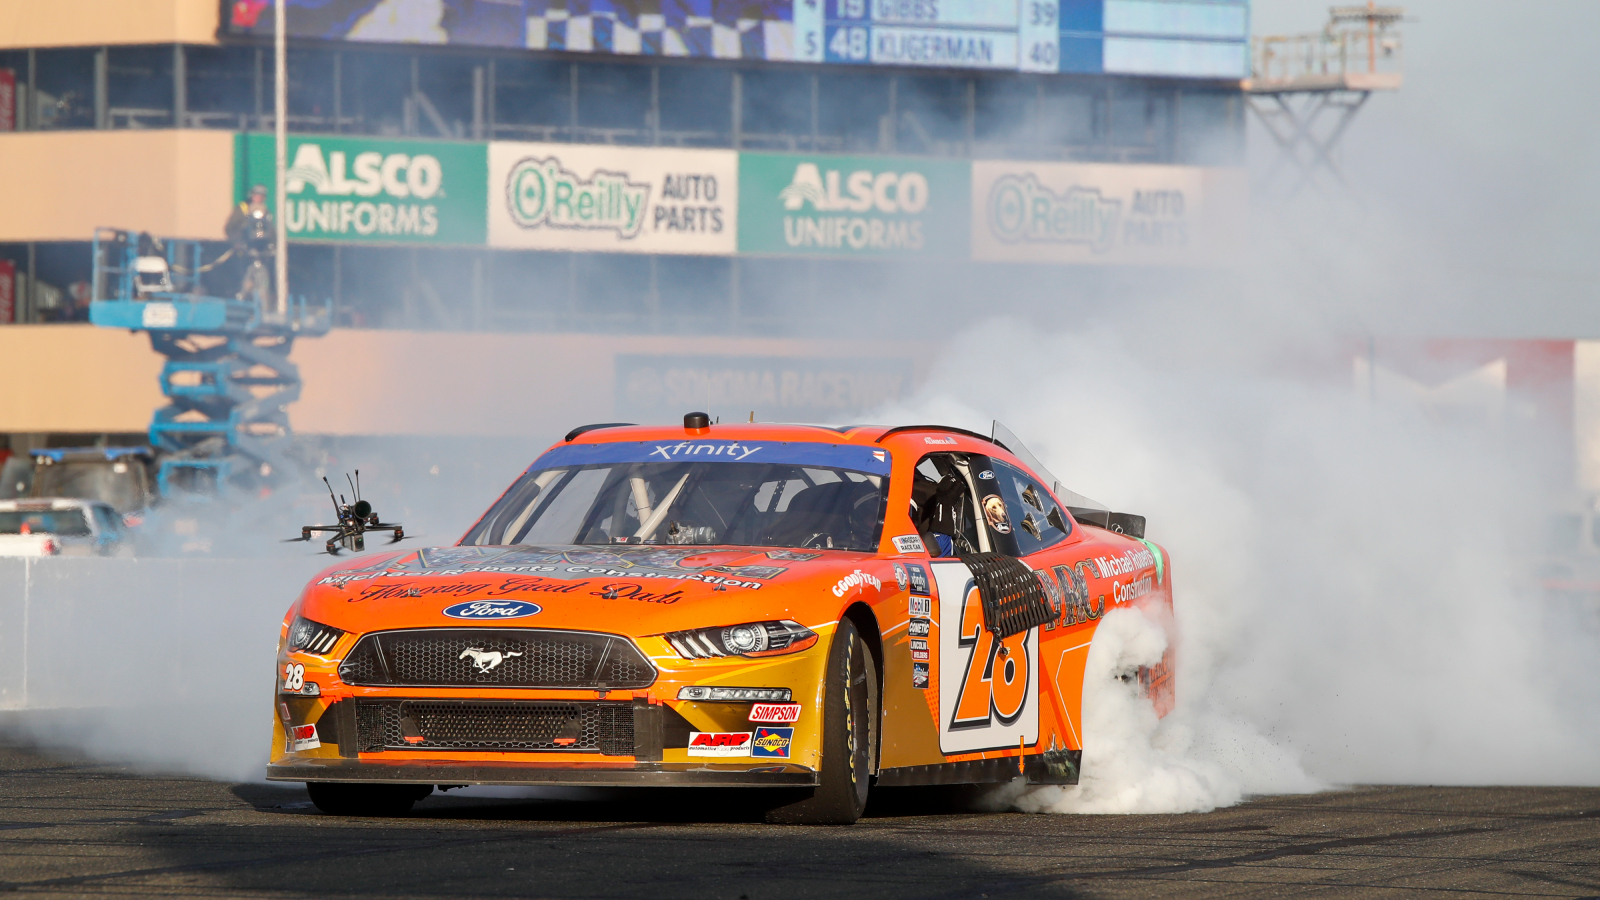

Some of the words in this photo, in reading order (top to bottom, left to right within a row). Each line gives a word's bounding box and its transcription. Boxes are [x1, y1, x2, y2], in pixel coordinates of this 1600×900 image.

[1031, 2, 1058, 27] 39
[804, 31, 818, 57] 5
[829, 26, 868, 60] 48
[877, 34, 993, 63] KLIGERMAN
[1030, 42, 1058, 66] 40
[286, 143, 442, 199] ALSCO
[514, 166, 641, 231] O'Reilly
[662, 173, 718, 201] AUTO
[778, 163, 929, 214] ALSCO
[995, 182, 1111, 243] O'Reilly
[1132, 188, 1186, 217] AUTO
[286, 199, 438, 236] UNIFORMS
[654, 205, 723, 233] PARTS
[783, 215, 924, 250] UNIFORMS
[649, 440, 763, 461] xfinity
[316, 569, 434, 586] Michael
[439, 564, 558, 576] Roberts
[565, 565, 763, 590] Construction
[1094, 552, 1133, 578] Michael
[487, 577, 590, 596] Great
[589, 582, 685, 605] Dads
[831, 569, 882, 598] GOODYEAR
[459, 601, 523, 616] Ford
[909, 598, 924, 612] Mobil
[908, 622, 930, 634] COMETIC
[949, 578, 1030, 732] 28
[284, 662, 304, 690] 28
[752, 704, 798, 721] SIMPSON
[690, 733, 750, 746] ARP
[755, 737, 788, 748] SUNOCO
